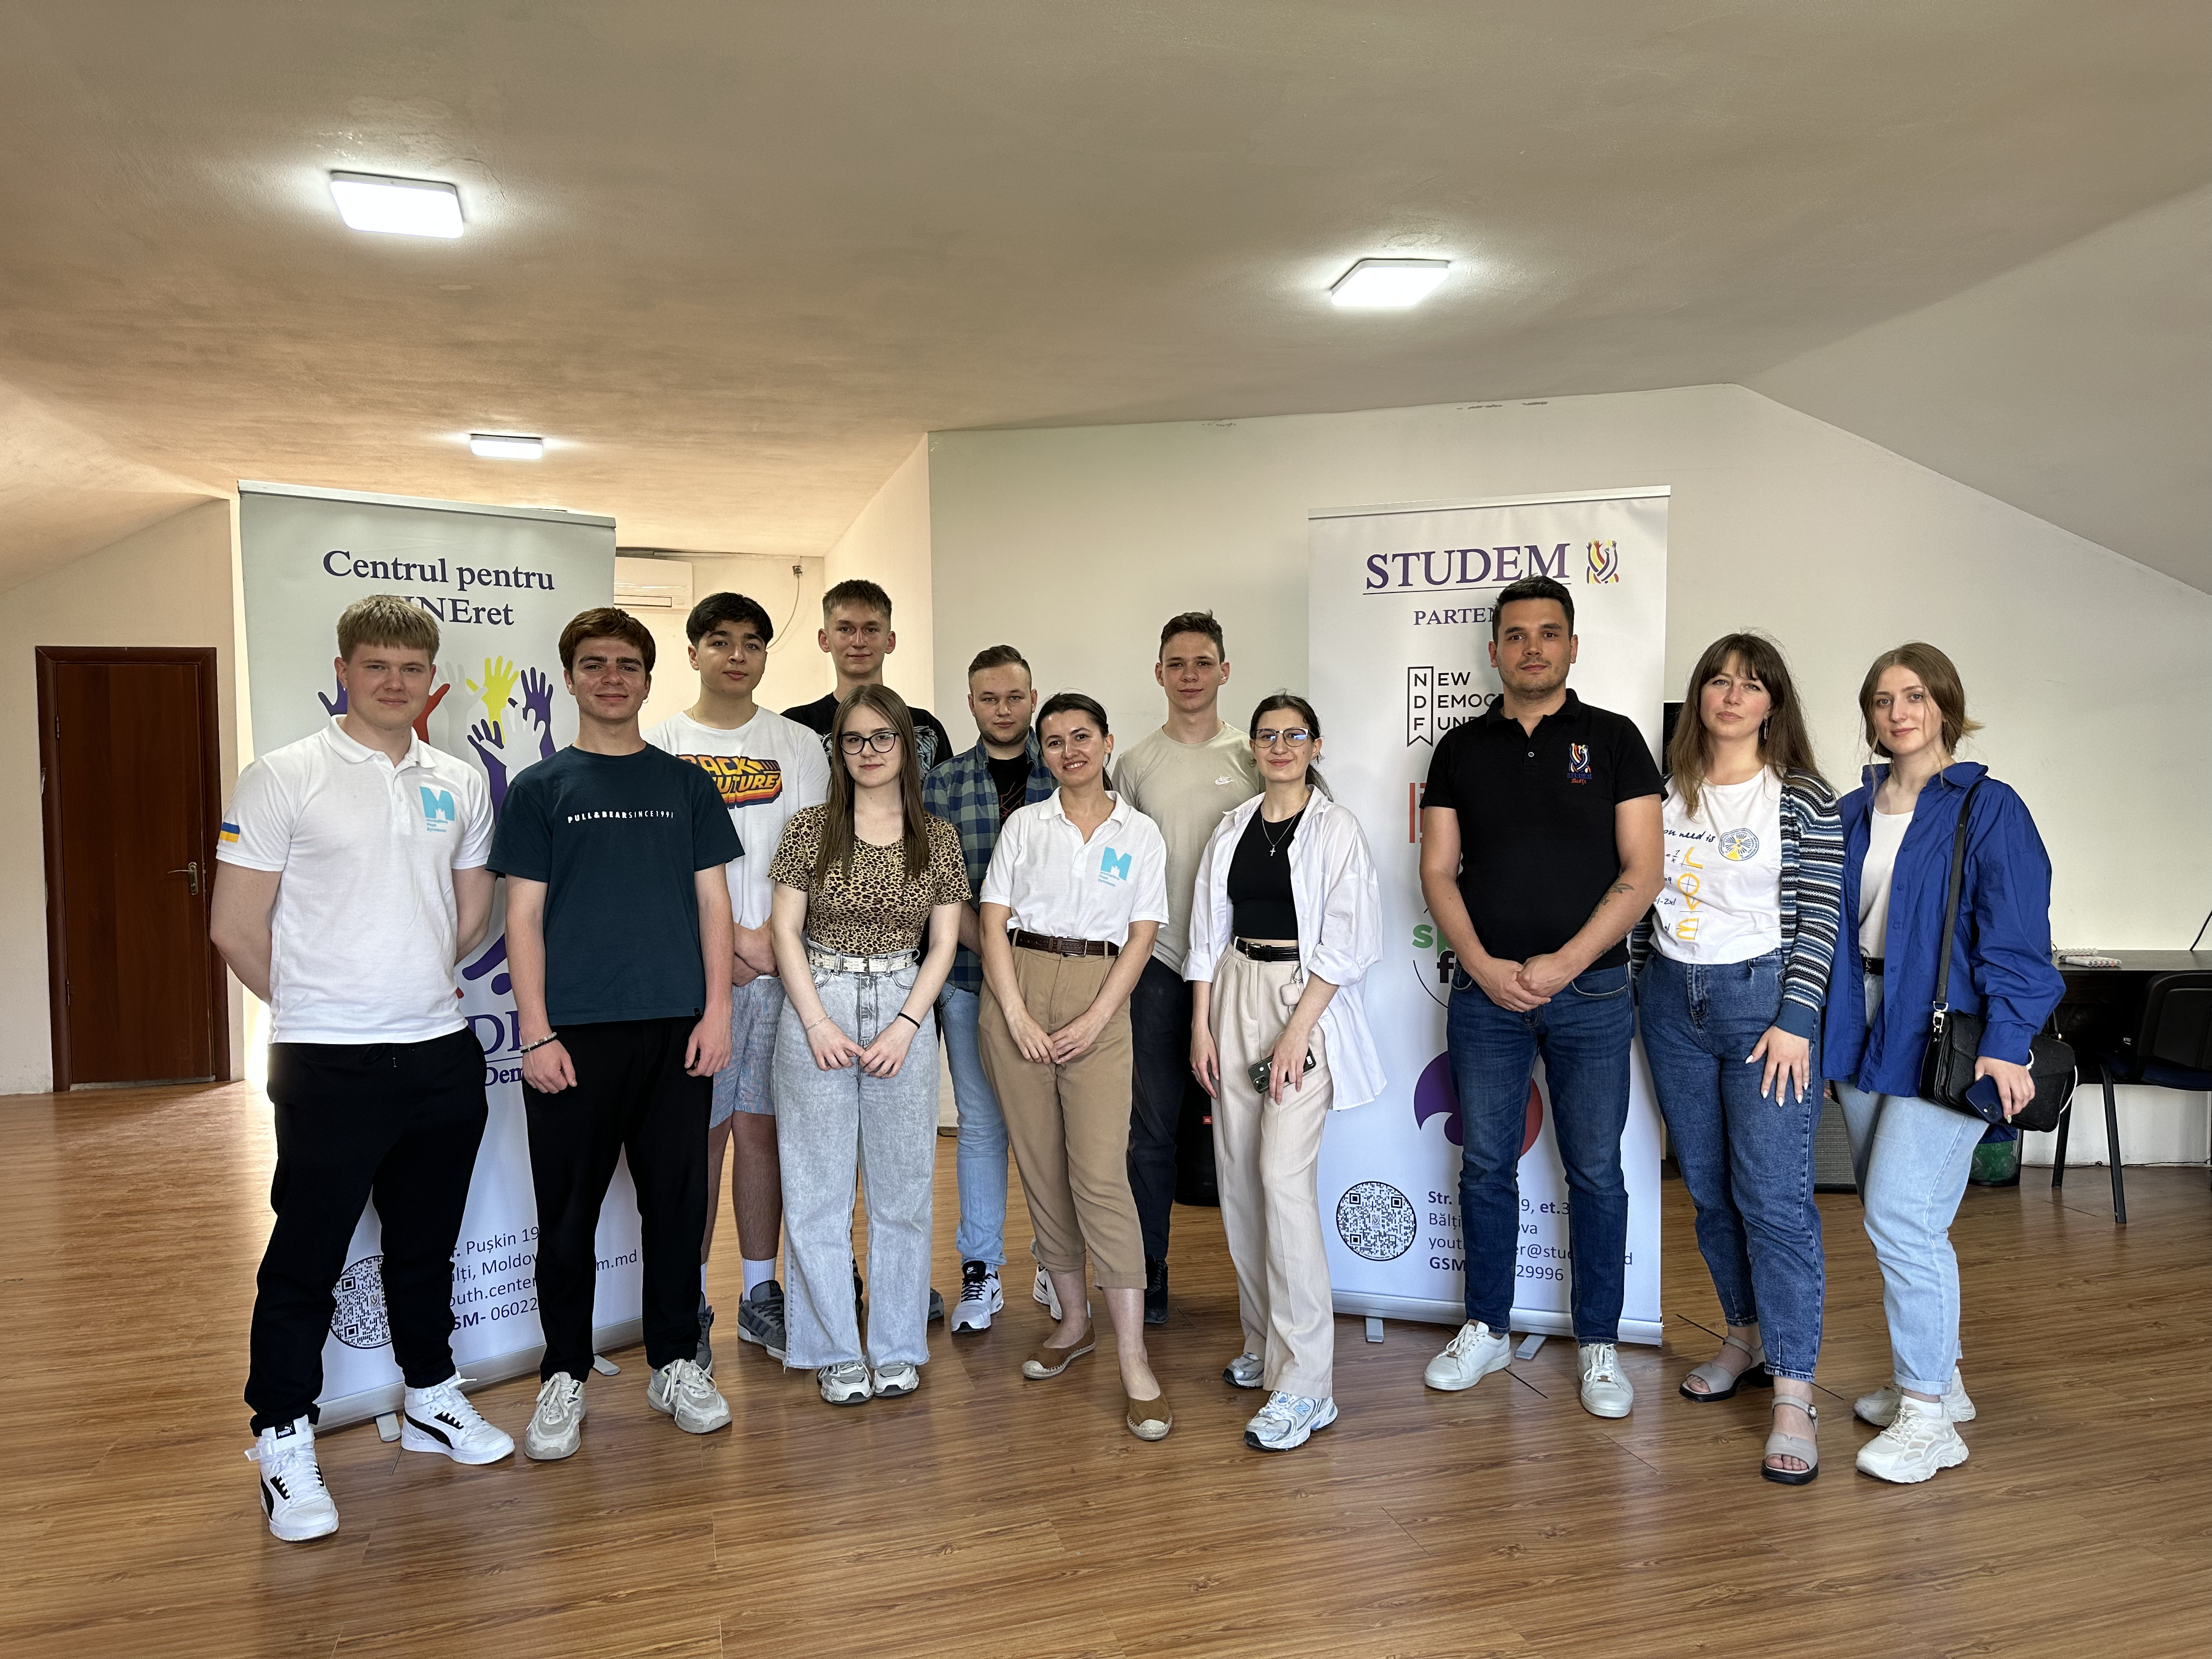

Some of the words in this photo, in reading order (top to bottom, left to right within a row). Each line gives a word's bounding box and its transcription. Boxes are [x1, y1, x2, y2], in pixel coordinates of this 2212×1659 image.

[323, 550, 449, 583] Centrul
[456, 566, 555, 592] pentru
[1366, 543, 1571, 590] STUDEM
[375, 594, 515, 626] NEret
[712, 774, 778, 793] UTURE
[1679, 831, 1707, 840] need
[1705, 834, 1716, 843] is
[1428, 1190, 1453, 1205] Str.
[466, 1233, 517, 1255] Pușkin
